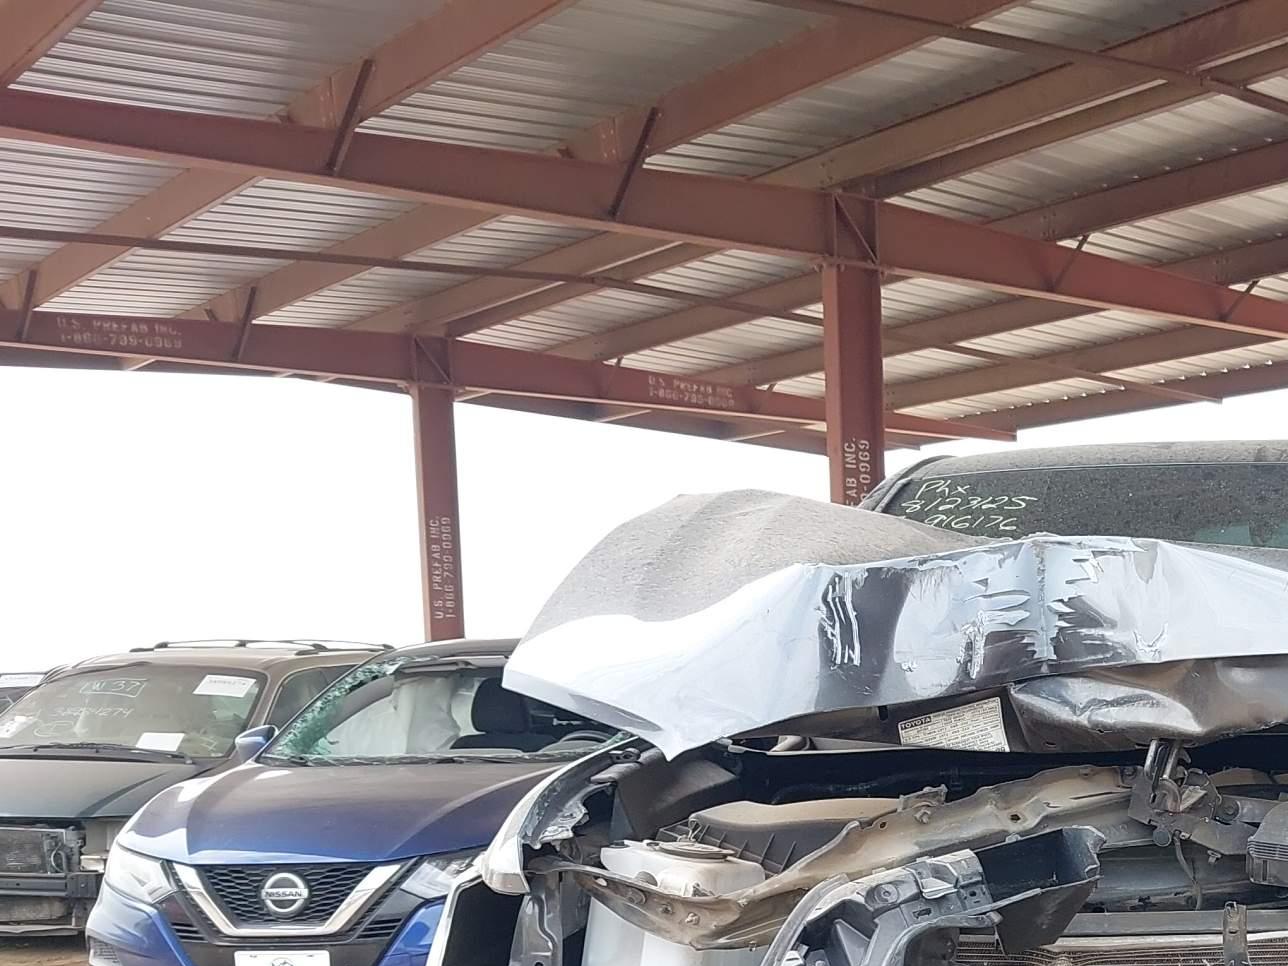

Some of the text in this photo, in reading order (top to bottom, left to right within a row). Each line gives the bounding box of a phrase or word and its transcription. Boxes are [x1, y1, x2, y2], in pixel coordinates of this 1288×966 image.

[843, 437, 857, 468] INC.
[431, 544, 443, 591] PREFAB
[900, 716, 931, 730] TOYOTA
[264, 890, 303, 898] NISSAN
